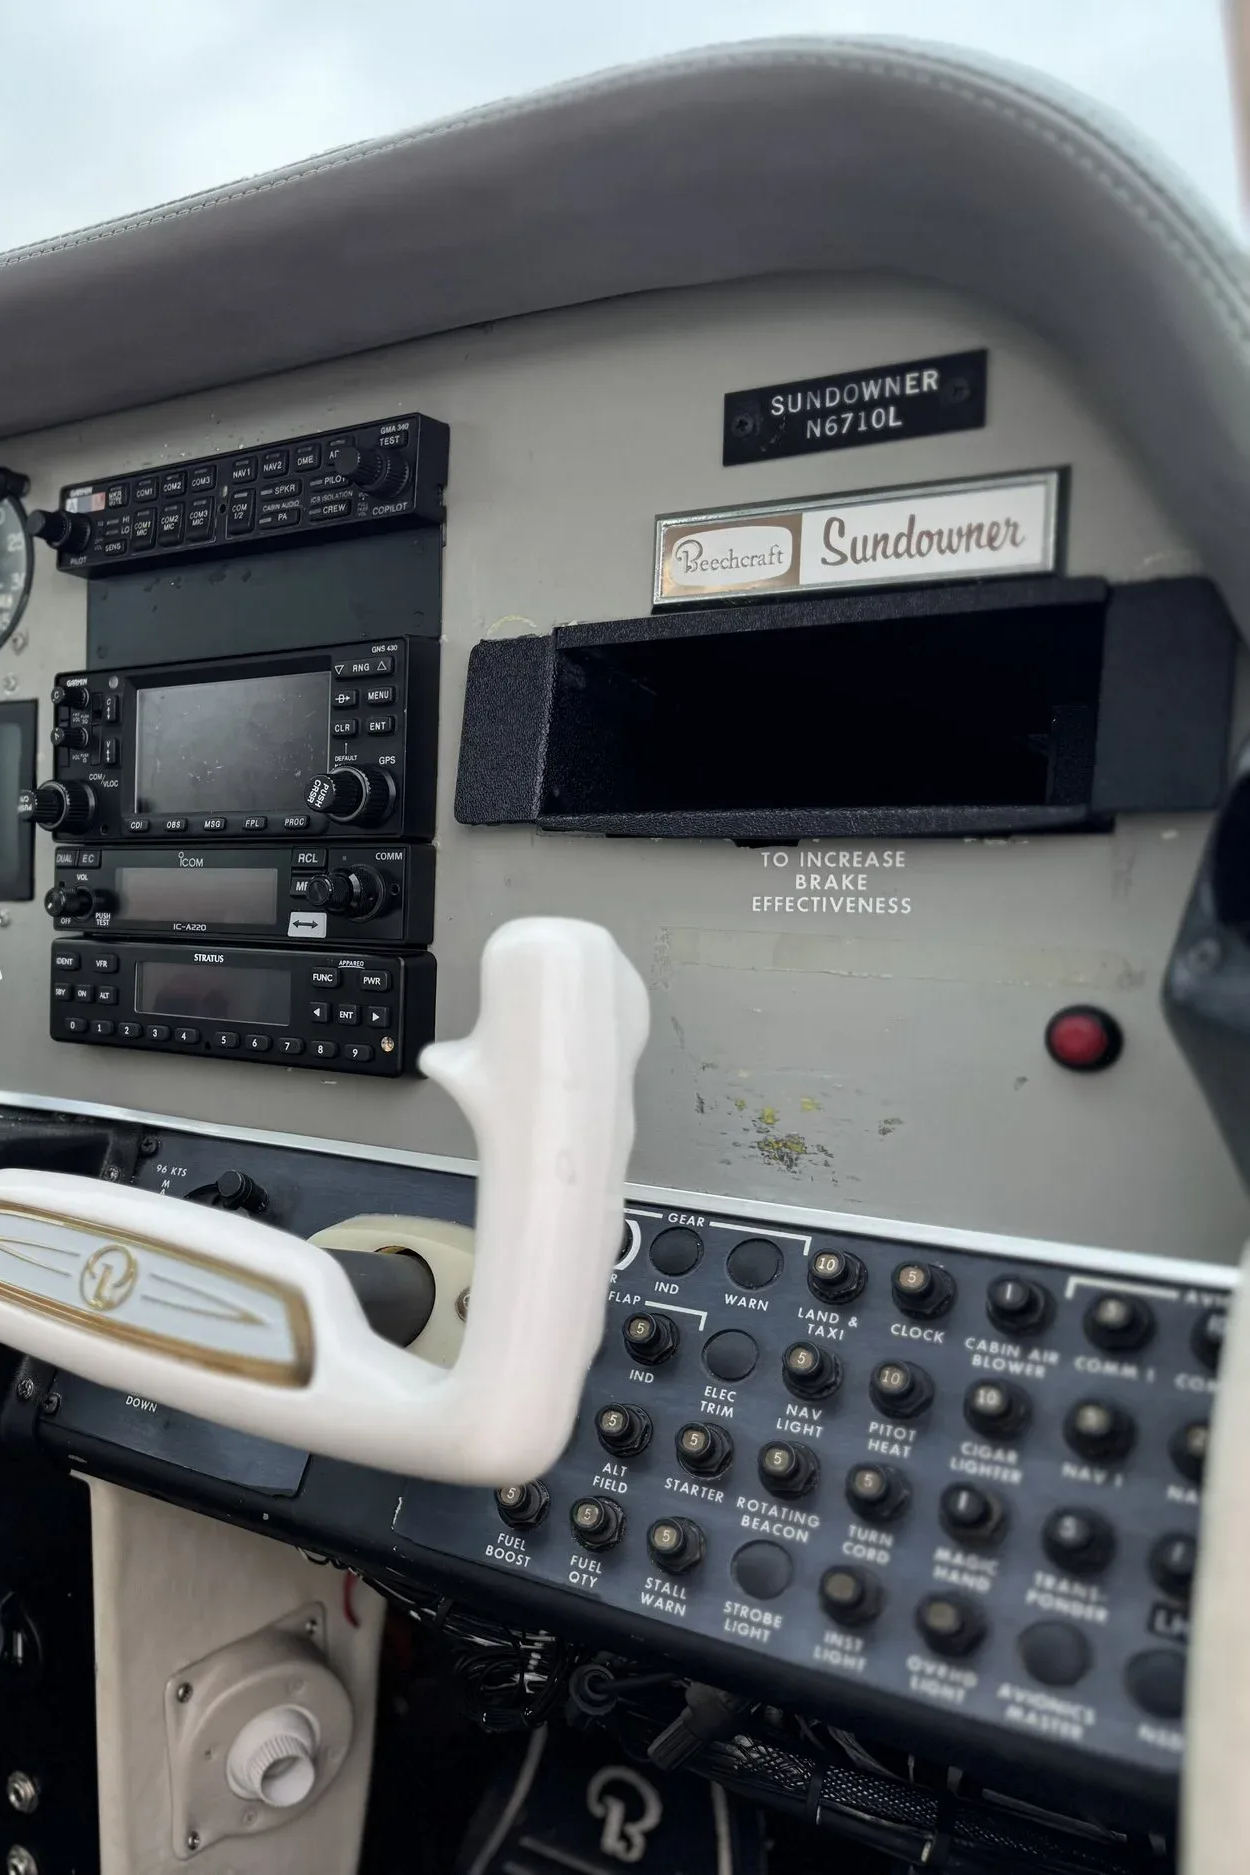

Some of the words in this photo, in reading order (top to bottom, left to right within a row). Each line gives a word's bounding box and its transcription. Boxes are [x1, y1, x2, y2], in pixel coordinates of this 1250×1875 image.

[771, 369, 938, 416] SUNDOWNER
[380, 425, 396, 434] GMA
[806, 407, 902, 438] N6710L
[380, 435, 400, 446] TEST
[263, 462, 282, 472] NAV2
[297, 455, 314, 466] DME
[163, 481, 181, 492] COM2
[191, 477, 210, 487] COM3
[136, 489, 152, 498] COM1
[274, 484, 296, 495] SPKR
[232, 503, 247, 512] COM
[263, 503, 281, 512] CABIN
[282, 500, 300, 509] AUDIO
[323, 504, 346, 514] CREW
[372, 502, 408, 516] COPILOT
[161, 515, 179, 525] COM2
[190, 510, 208, 520] COM3
[278, 513, 287, 521] PA
[821, 513, 1025, 567] Sundowner
[105, 543, 121, 552] SENS
[675, 539, 783, 574] Beechcraft
[372, 645, 386, 653] GNS
[353, 663, 370, 672] RNG
[368, 690, 389, 700] MENU
[335, 723, 350, 732] CLR
[370, 722, 386, 731] ENT
[379, 756, 396, 765] GPS
[307, 779, 322, 804] CRSR
[315, 783, 329, 808] PUSH
[130, 822, 143, 830] CDI
[166, 821, 181, 829] OBS
[204, 820, 221, 828] MSG
[245, 819, 259, 827] FPL
[284, 818, 305, 827] PROC
[56, 854, 73, 863] DUAL
[298, 853, 318, 863] RCL
[375, 852, 403, 860] COMM
[761, 852, 788, 868] TO
[800, 851, 906, 868] INCREASE
[796, 874, 867, 890] BRAKE
[752, 896, 911, 914] EFFECTIVENESS
[95, 912, 111, 920] PUSH
[173, 923, 206, 931] IC-A220
[96, 960, 108, 968] VFR
[194, 953, 224, 963] STRATUS
[312, 973, 333, 982] FUNC
[363, 976, 381, 986] PWR
[339, 1011, 354, 1019] ENT
[156, 1164, 167, 1174] 96
[170, 1166, 188, 1177] KTS
[668, 1213, 705, 1227] GEAR
[818, 1257, 836, 1271] 10
[908, 1270, 917, 1282] 5
[654, 1281, 679, 1294] IND
[608, 1291, 641, 1305] FLAP
[724, 1293, 769, 1312] WARN
[798, 1307, 840, 1325] LAND
[848, 1316, 858, 1328] &
[636, 1322, 645, 1335] 5
[806, 1323, 845, 1341] TAXI
[890, 1323, 945, 1344] CLOCK
[797, 1352, 807, 1364] 5
[964, 1337, 1020, 1358] CABIN
[1028, 1350, 1060, 1366] AIR
[972, 1354, 1047, 1379] BLOWER
[1074, 1355, 1138, 1380] COMM
[629, 1369, 655, 1384] IND
[882, 1371, 901, 1385] 10
[704, 1386, 737, 1403] ELEC
[125, 1395, 158, 1413] DOWN
[700, 1400, 734, 1418] TRIM
[786, 1403, 823, 1421] NAV
[608, 1414, 617, 1427] 5
[776, 1417, 824, 1438] LIGHT
[868, 1421, 917, 1442] PITOT
[690, 1433, 699, 1446] 5
[868, 1438, 912, 1459] HEAT
[961, 1441, 1018, 1464] CIGAR
[773, 1452, 782, 1465] 5
[602, 1462, 628, 1477] ALT
[950, 1457, 1023, 1485] LIGHTER
[1061, 1462, 1107, 1485] NAV
[593, 1475, 628, 1494] FIELD
[864, 1474, 873, 1487] 5
[664, 1477, 725, 1503] STARTER
[584, 1507, 593, 1520] 5
[736, 1496, 821, 1529] ROTATING
[662, 1529, 671, 1542] 5
[741, 1514, 809, 1544] BEACON
[848, 1524, 894, 1547] TURN
[497, 1532, 526, 1552] FUEL
[485, 1545, 531, 1568] BOOST
[570, 1555, 602, 1574] FUEL
[568, 1570, 598, 1589] QTY
[644, 1577, 688, 1600] STALL
[641, 1592, 686, 1617] WARN
[723, 1601, 783, 1629] STROBE
[724, 1618, 772, 1643] LIGHT
[823, 1631, 864, 1652] INST
[813, 1645, 867, 1673] LIGHT
